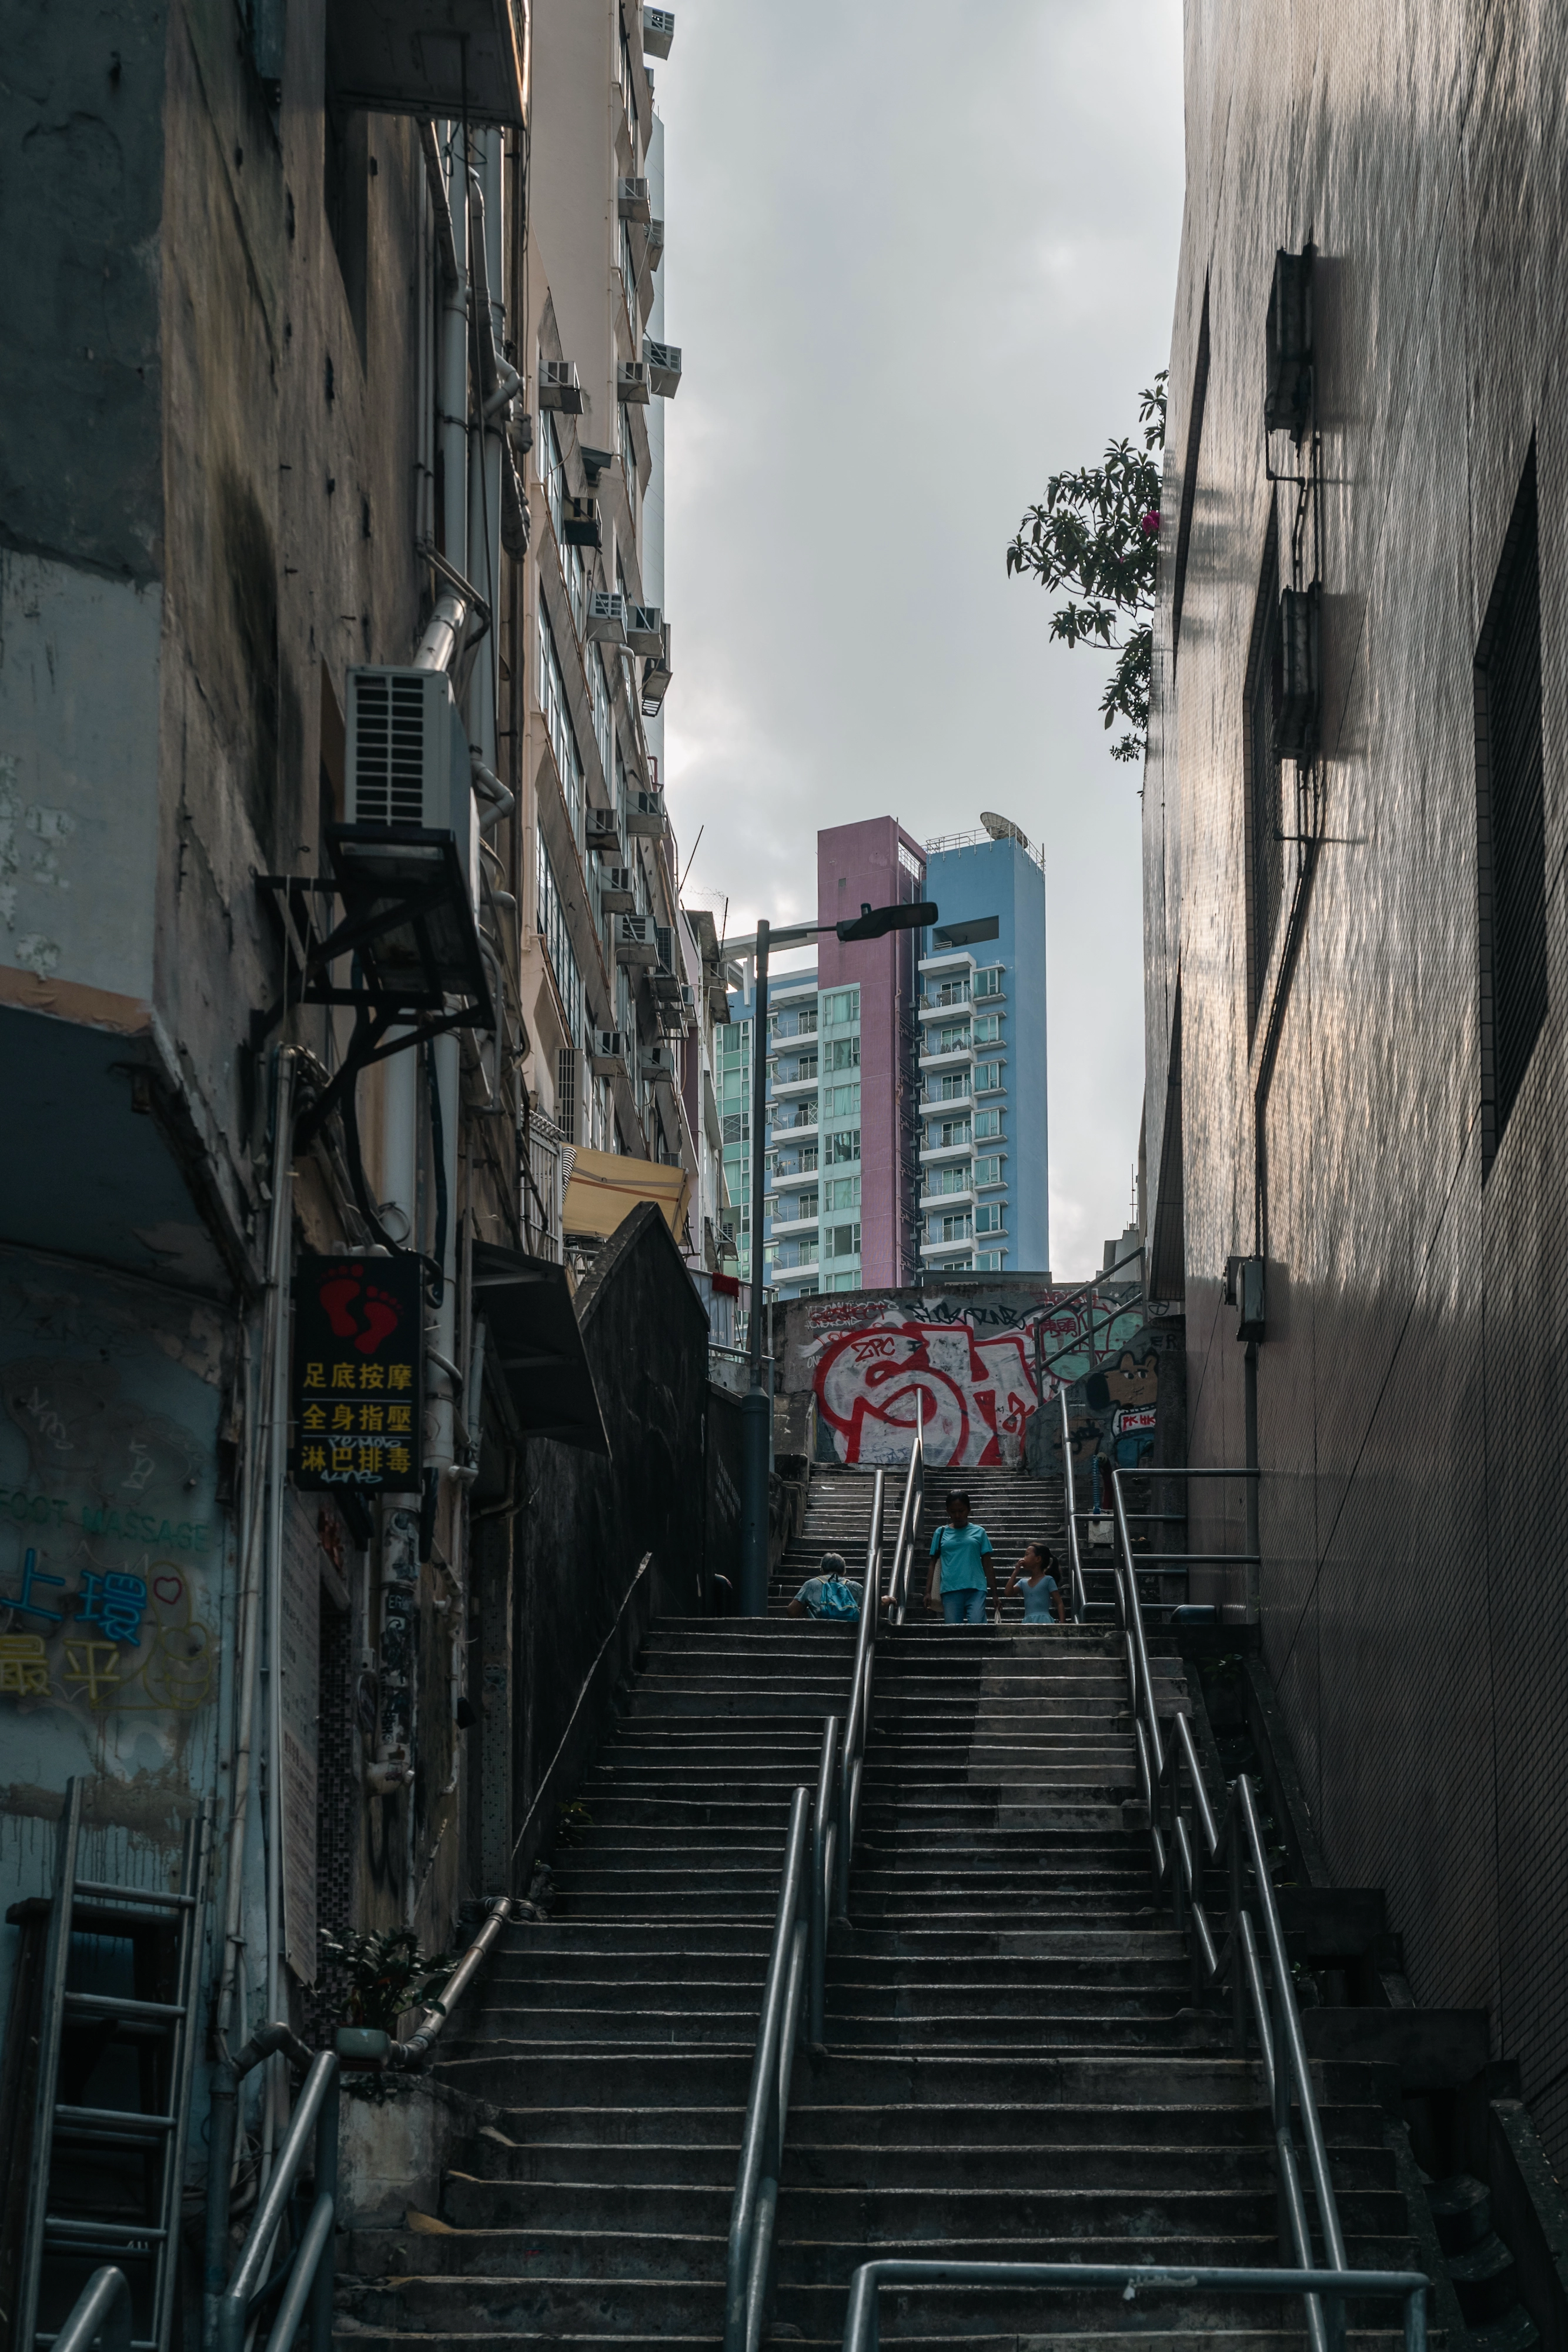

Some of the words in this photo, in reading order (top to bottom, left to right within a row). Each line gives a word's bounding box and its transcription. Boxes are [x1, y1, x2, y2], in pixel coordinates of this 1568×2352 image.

[303, 1362, 412, 1390] 足底按摩
[302, 1404, 412, 1432] 全身指壓
[302, 1445, 411, 1474] 淋巴排毒
[81, 1506, 210, 1553] MASSAGE
